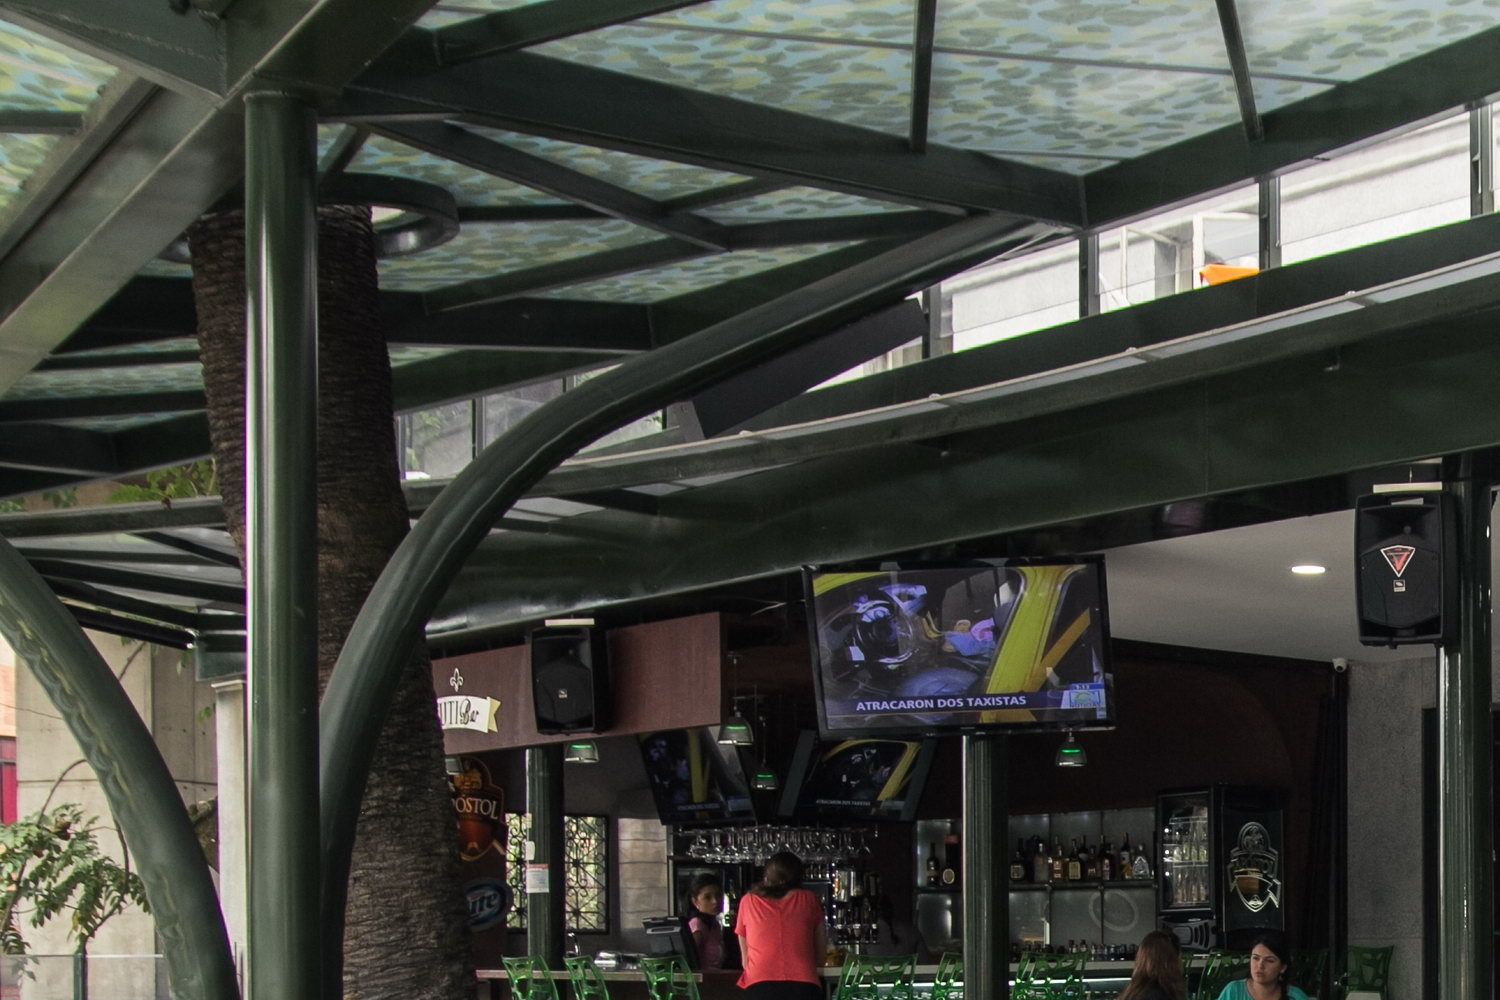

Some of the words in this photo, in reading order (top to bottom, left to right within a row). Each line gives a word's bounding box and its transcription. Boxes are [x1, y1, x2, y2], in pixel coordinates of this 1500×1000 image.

[856, 698, 934, 711] ATRACARON
[937, 697, 964, 708] DOS
[968, 695, 1026, 707] TAXISTAS
